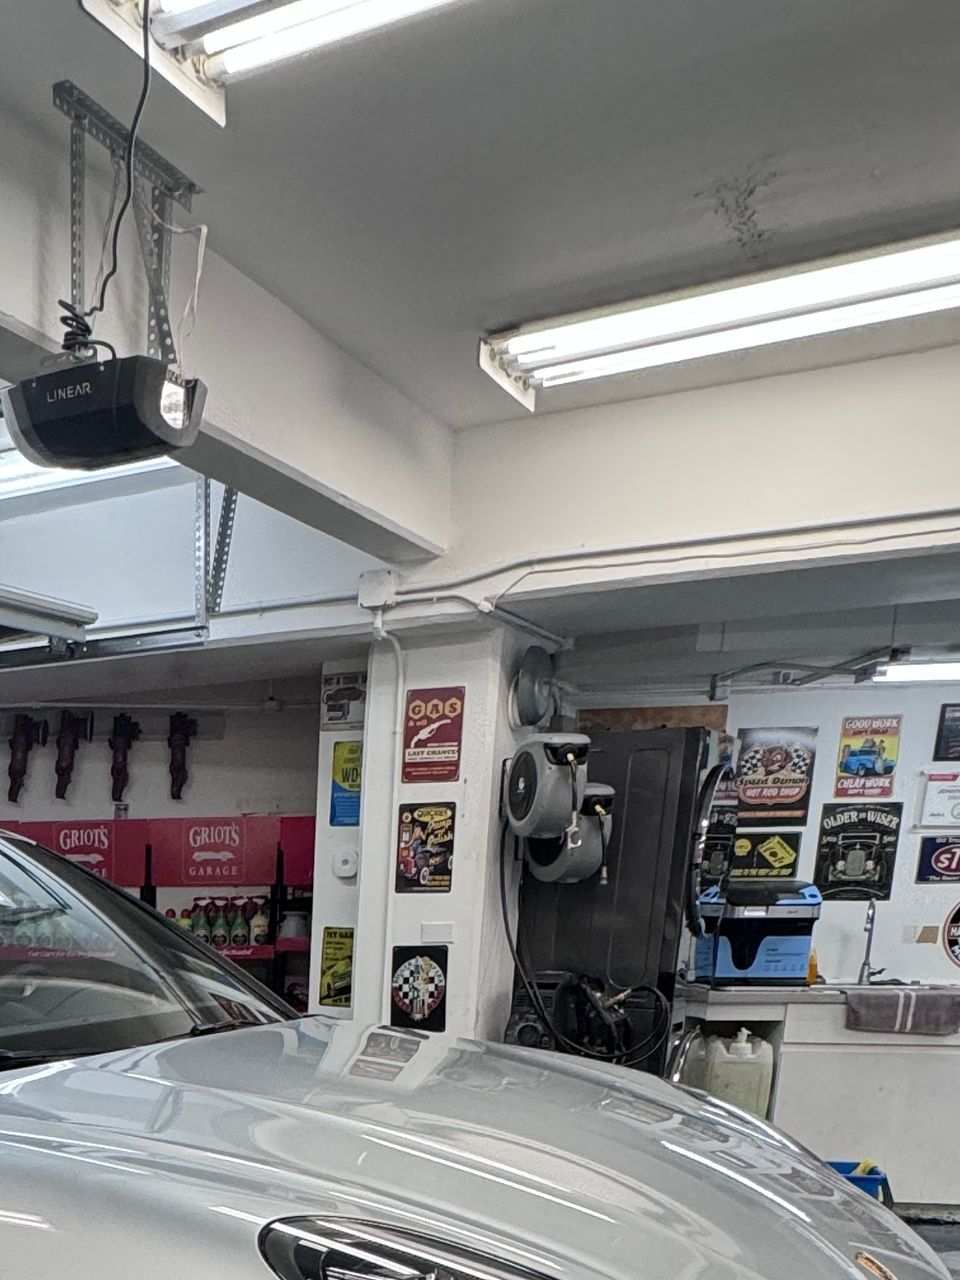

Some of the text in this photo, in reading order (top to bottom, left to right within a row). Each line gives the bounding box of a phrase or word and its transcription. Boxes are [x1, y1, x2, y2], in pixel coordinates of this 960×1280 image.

[47, 382, 92, 403] LINEAR
[410, 701, 459, 717] GAS
[845, 718, 899, 729] GOOD WORK
[342, 767, 361, 783] WD-
[837, 778, 891, 789] CHEAP WORK
[745, 788, 762, 797] HOT
[762, 788, 779, 797] ROD
[779, 787, 801, 796] SHOP
[823, 811, 859, 830] OLDER
[867, 810, 899, 830] WISER
[59, 824, 109, 850] GRIOT'S
[189, 822, 240, 847] GRIOT'S
[937, 848, 960, 869] ST
[190, 866, 238, 876] GARAGE
[339, 931, 354, 939] GAR
